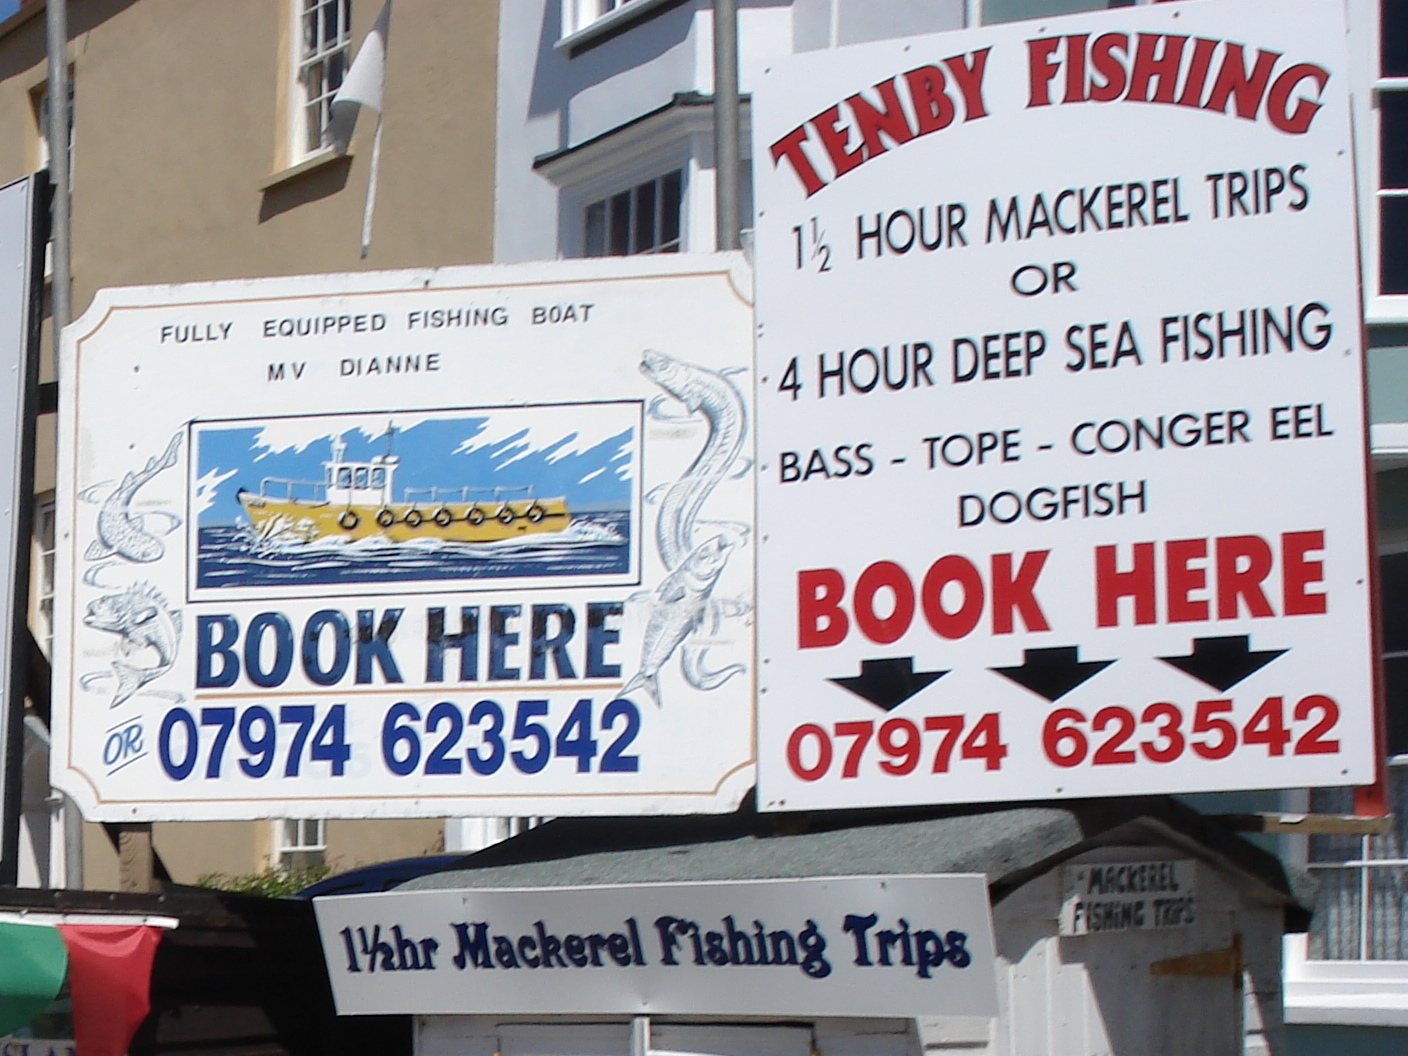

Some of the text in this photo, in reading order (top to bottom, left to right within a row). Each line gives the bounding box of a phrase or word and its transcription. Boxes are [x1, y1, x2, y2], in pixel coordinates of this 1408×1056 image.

[769, 32, 1331, 198] TENBY FISHING
[856, 203, 967, 259] HOUR
[986, 177, 1189, 244] MACKEREL
[1206, 163, 1310, 219] TRIPS
[1010, 262, 1078, 296] OR
[160, 303, 595, 344] FULLY EQUIPPED FISHING BOAT
[778, 302, 1333, 400] 4 HOUR DEEP SEA FISHING
[340, 354, 441, 376] DIANNE
[779, 444, 875, 483] BASS
[923, 429, 1020, 472] TOPE
[1071, 410, 1250, 457] CONGER
[1270, 403, 1333, 441] EEL
[958, 479, 1148, 527] DOGFISH
[797, 529, 1328, 650] BOOK HERE
[196, 602, 626, 690] BOOK HERE
[102, 700, 640, 781] OR 07974 623542
[785, 694, 1341, 781] 07974 623542
[1087, 862, 1180, 894] MACKEREL
[452, 919, 645, 970] Mackerel
[654, 915, 832, 979] Fishing
[842, 913, 971, 978] Trips
